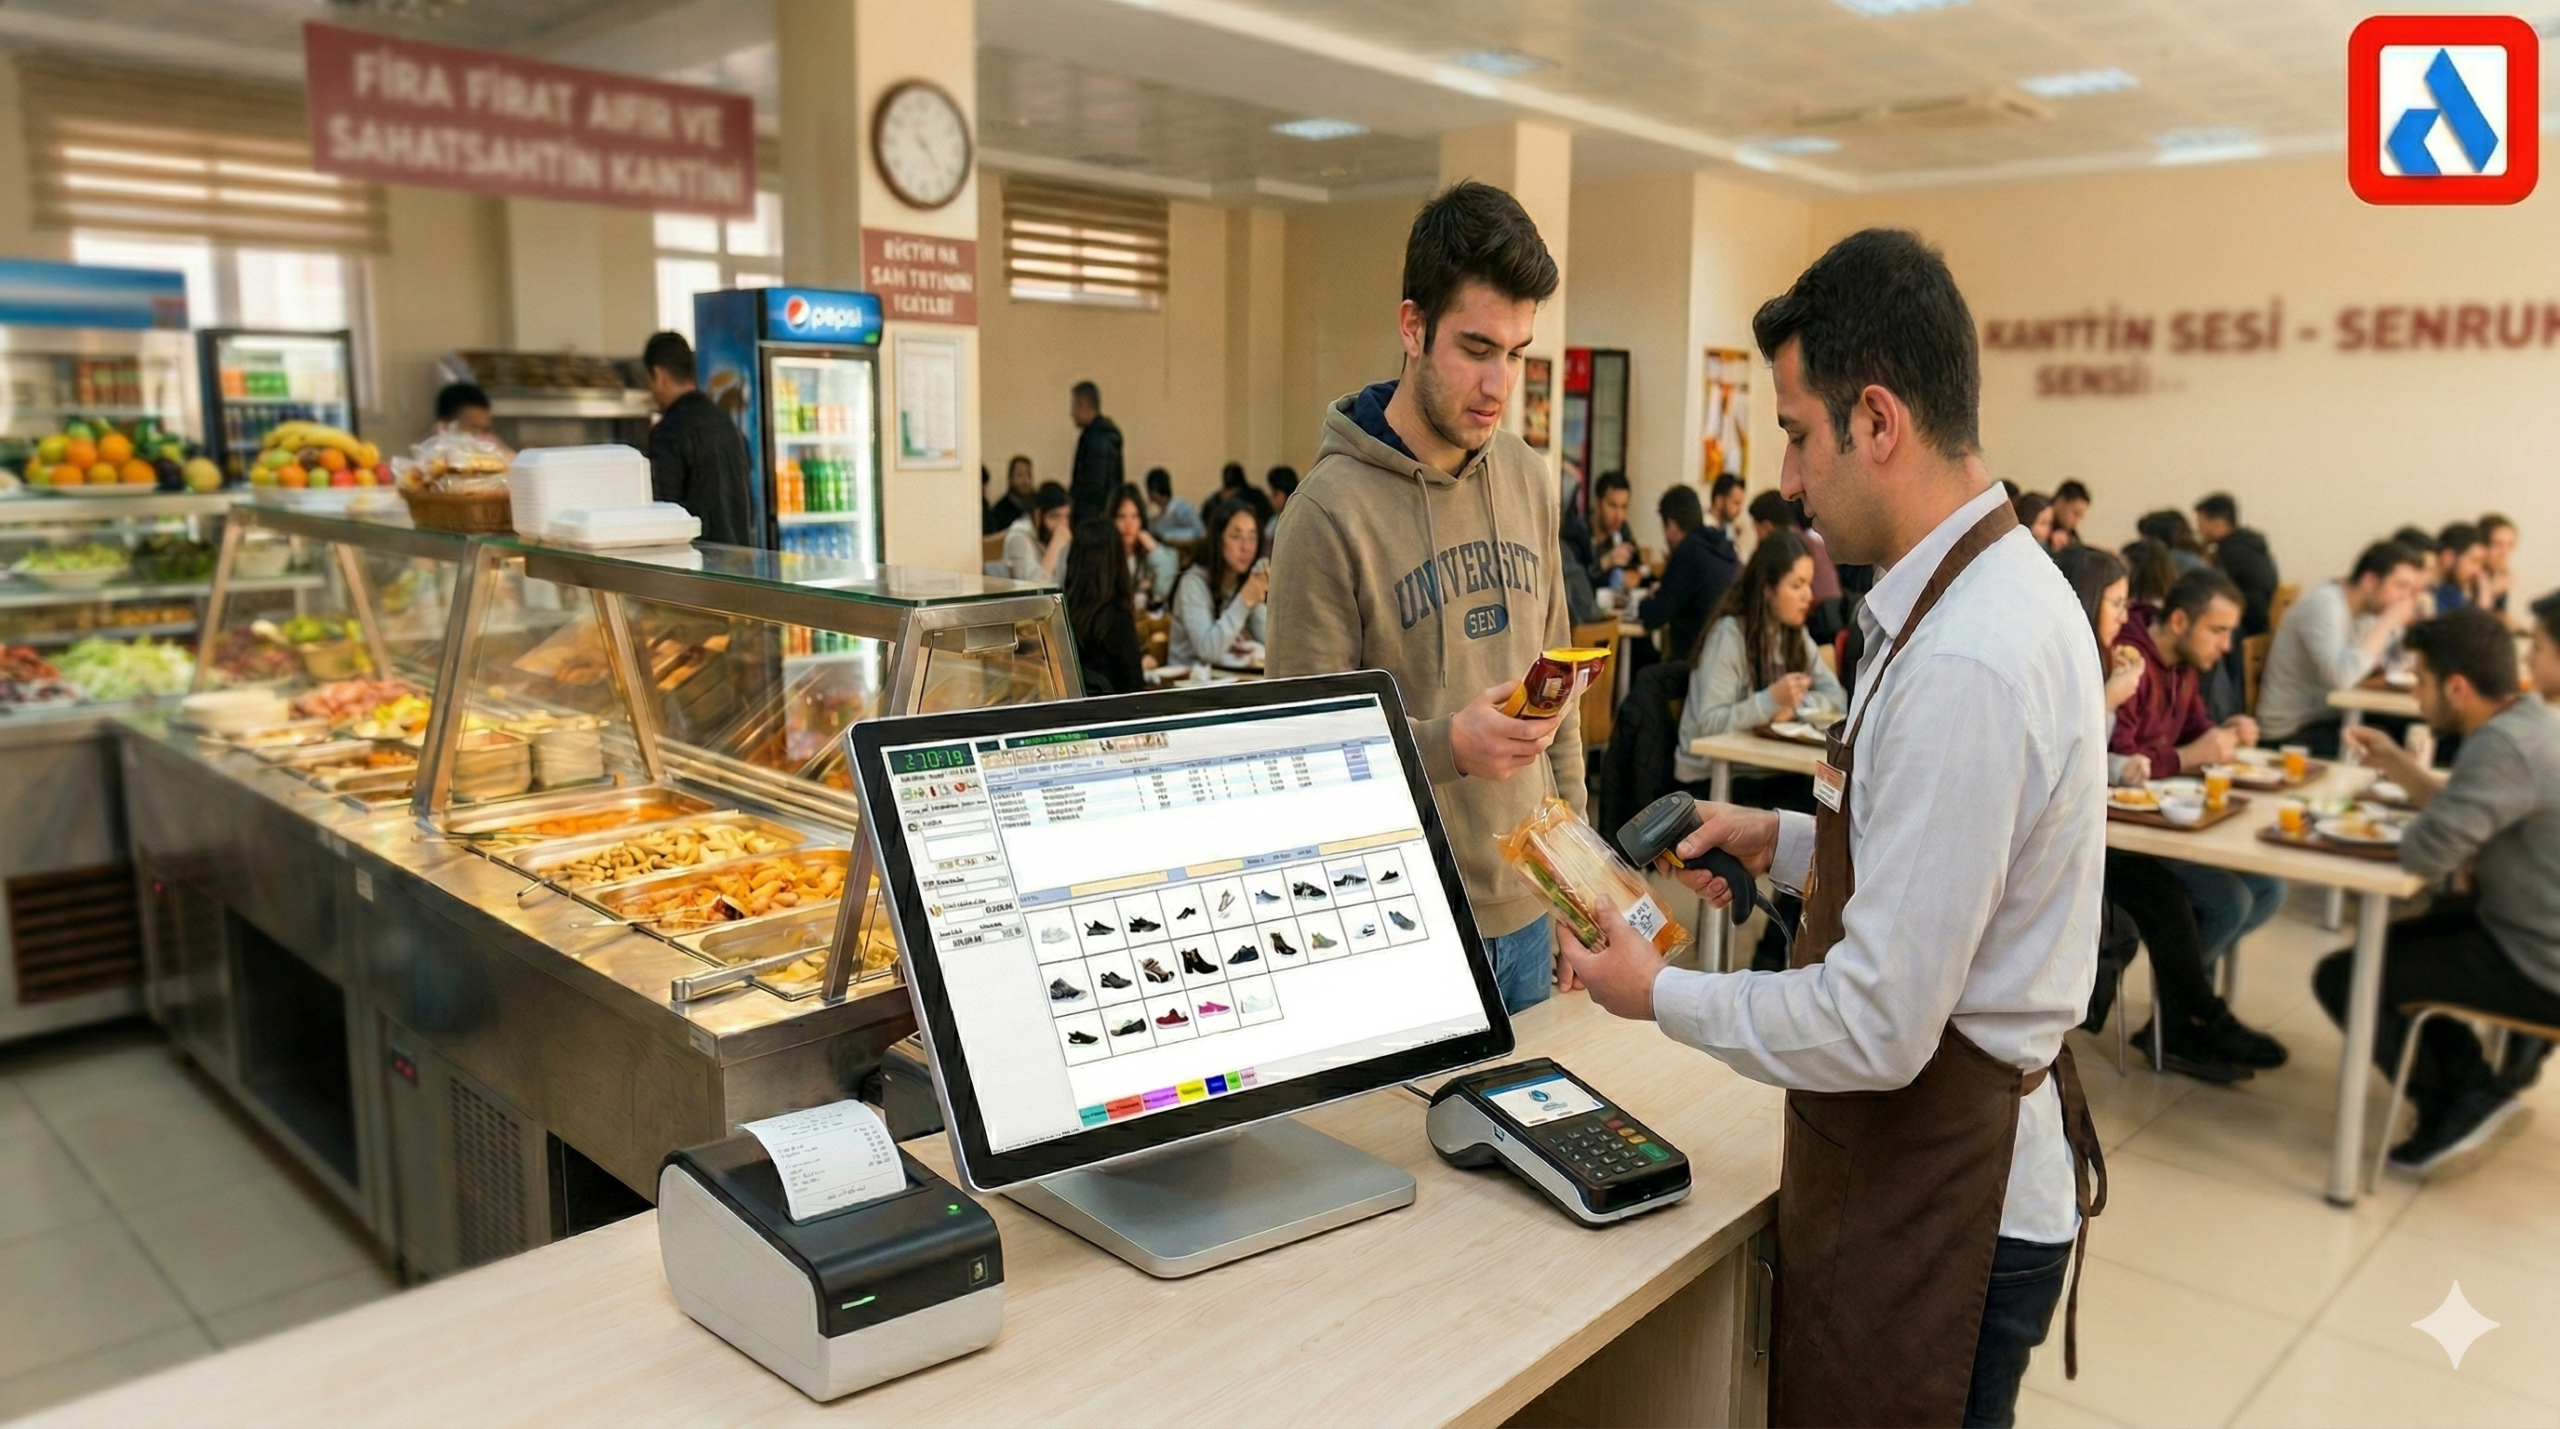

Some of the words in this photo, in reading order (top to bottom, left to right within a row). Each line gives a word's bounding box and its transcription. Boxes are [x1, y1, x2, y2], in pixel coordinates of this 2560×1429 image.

[680, 105, 724, 149] VE
[811, 305, 863, 332] pepsi
[2168, 296, 2283, 354] SESİ
